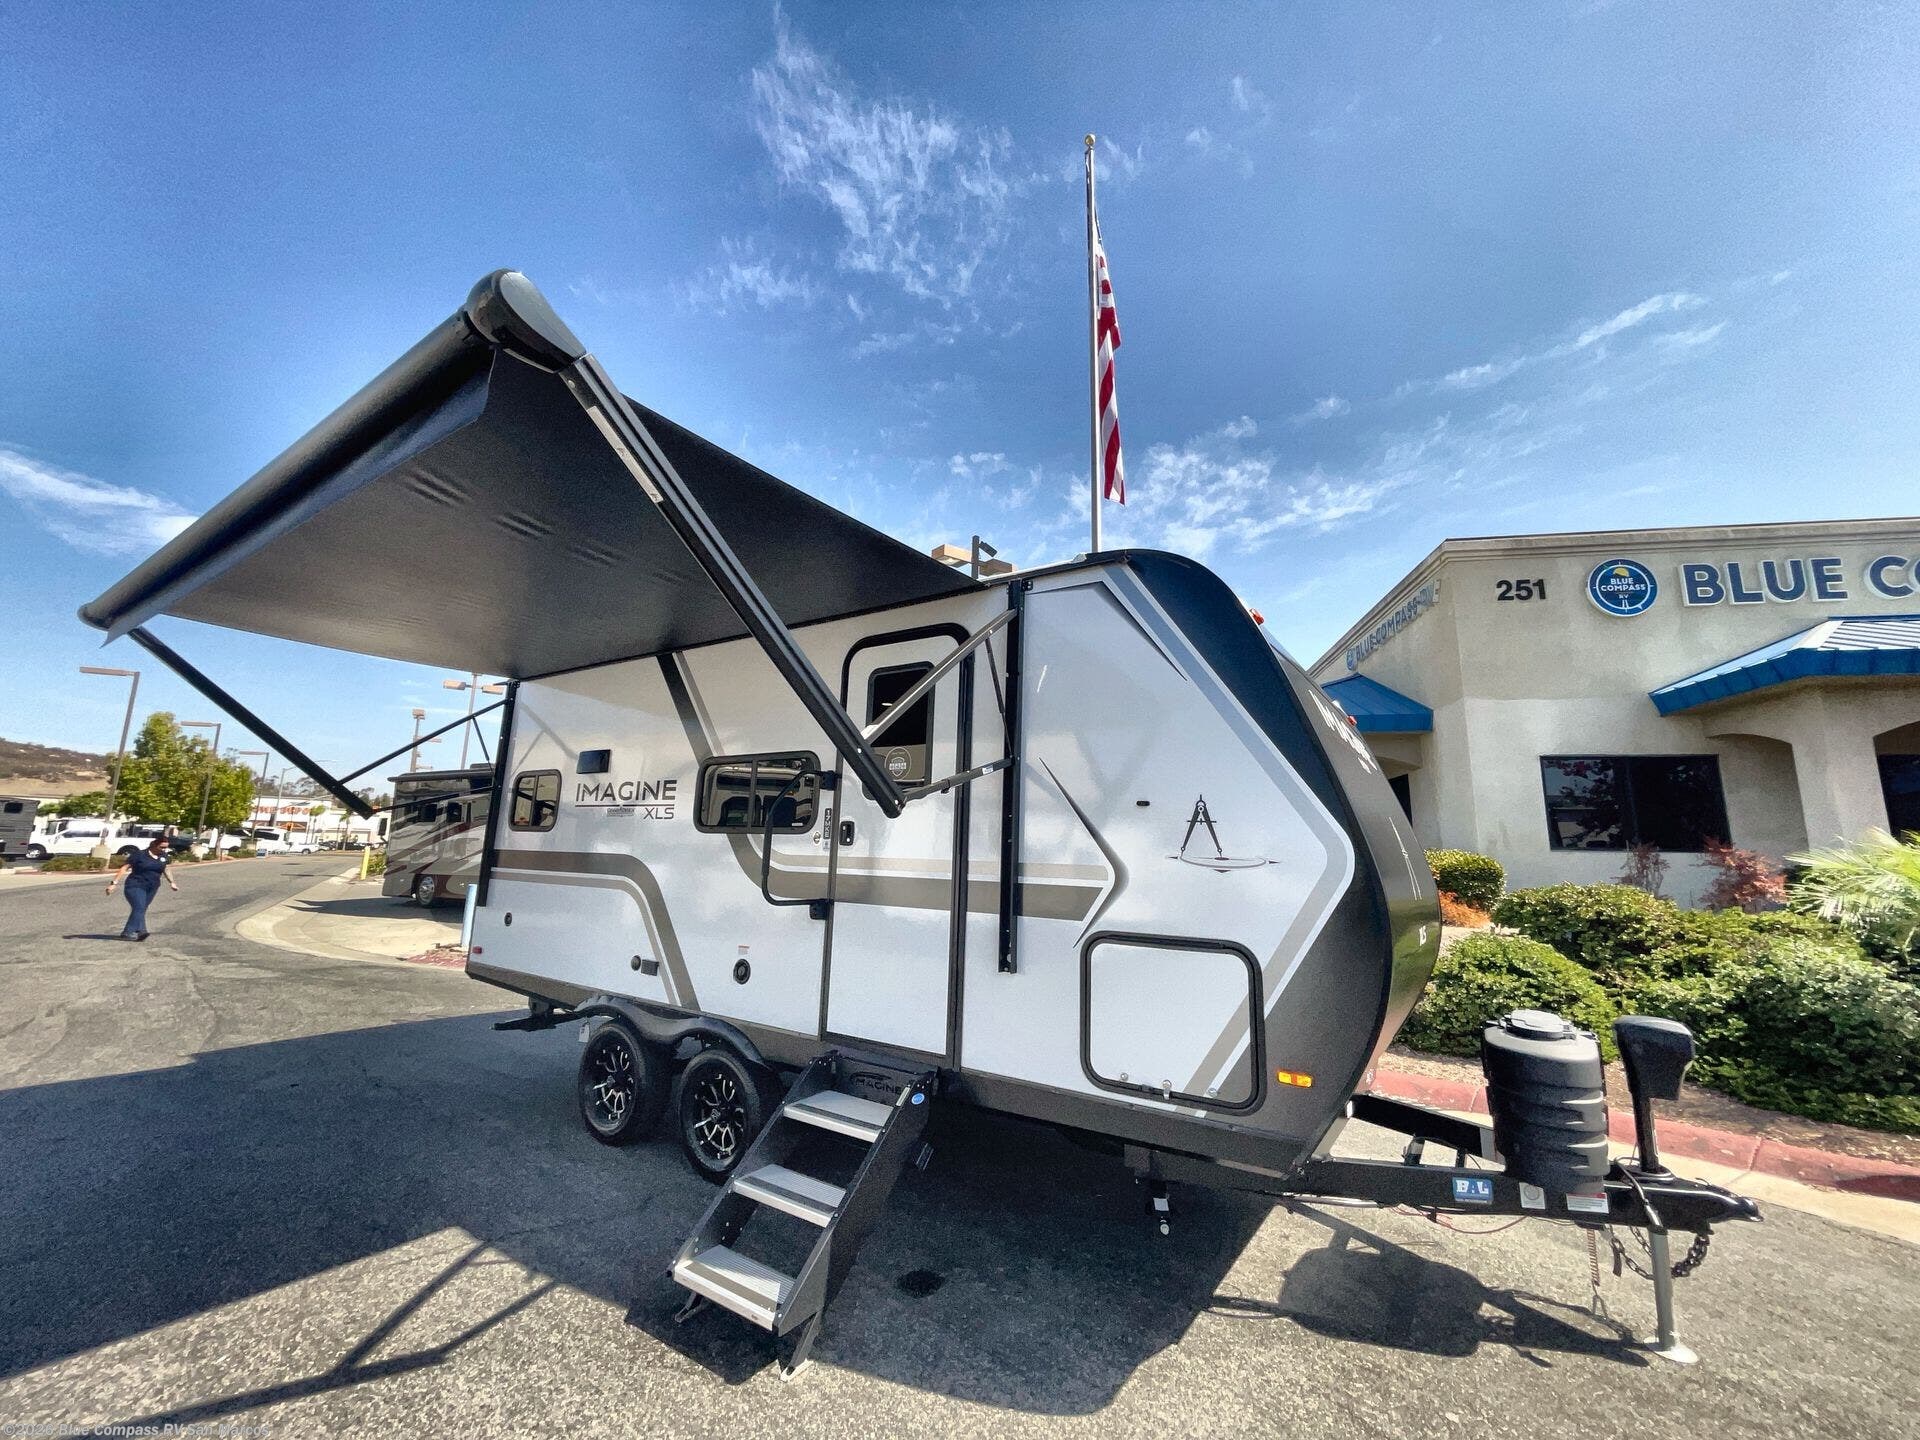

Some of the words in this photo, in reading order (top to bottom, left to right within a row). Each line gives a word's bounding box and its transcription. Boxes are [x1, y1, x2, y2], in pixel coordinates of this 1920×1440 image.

[1496, 578, 1547, 601] 251
[1600, 584, 1646, 592] COMPASS
[1610, 577, 1634, 585] BLUE
[1681, 557, 1849, 607] BLUE
[1864, 555, 1920, 600] C
[1355, 633, 1376, 661] BLUE
[1375, 597, 1418, 645] COMPASS
[575, 779, 678, 802] IMAGINE
[643, 807, 675, 820] XLS
[852, 1077, 902, 1095] MAGINE
